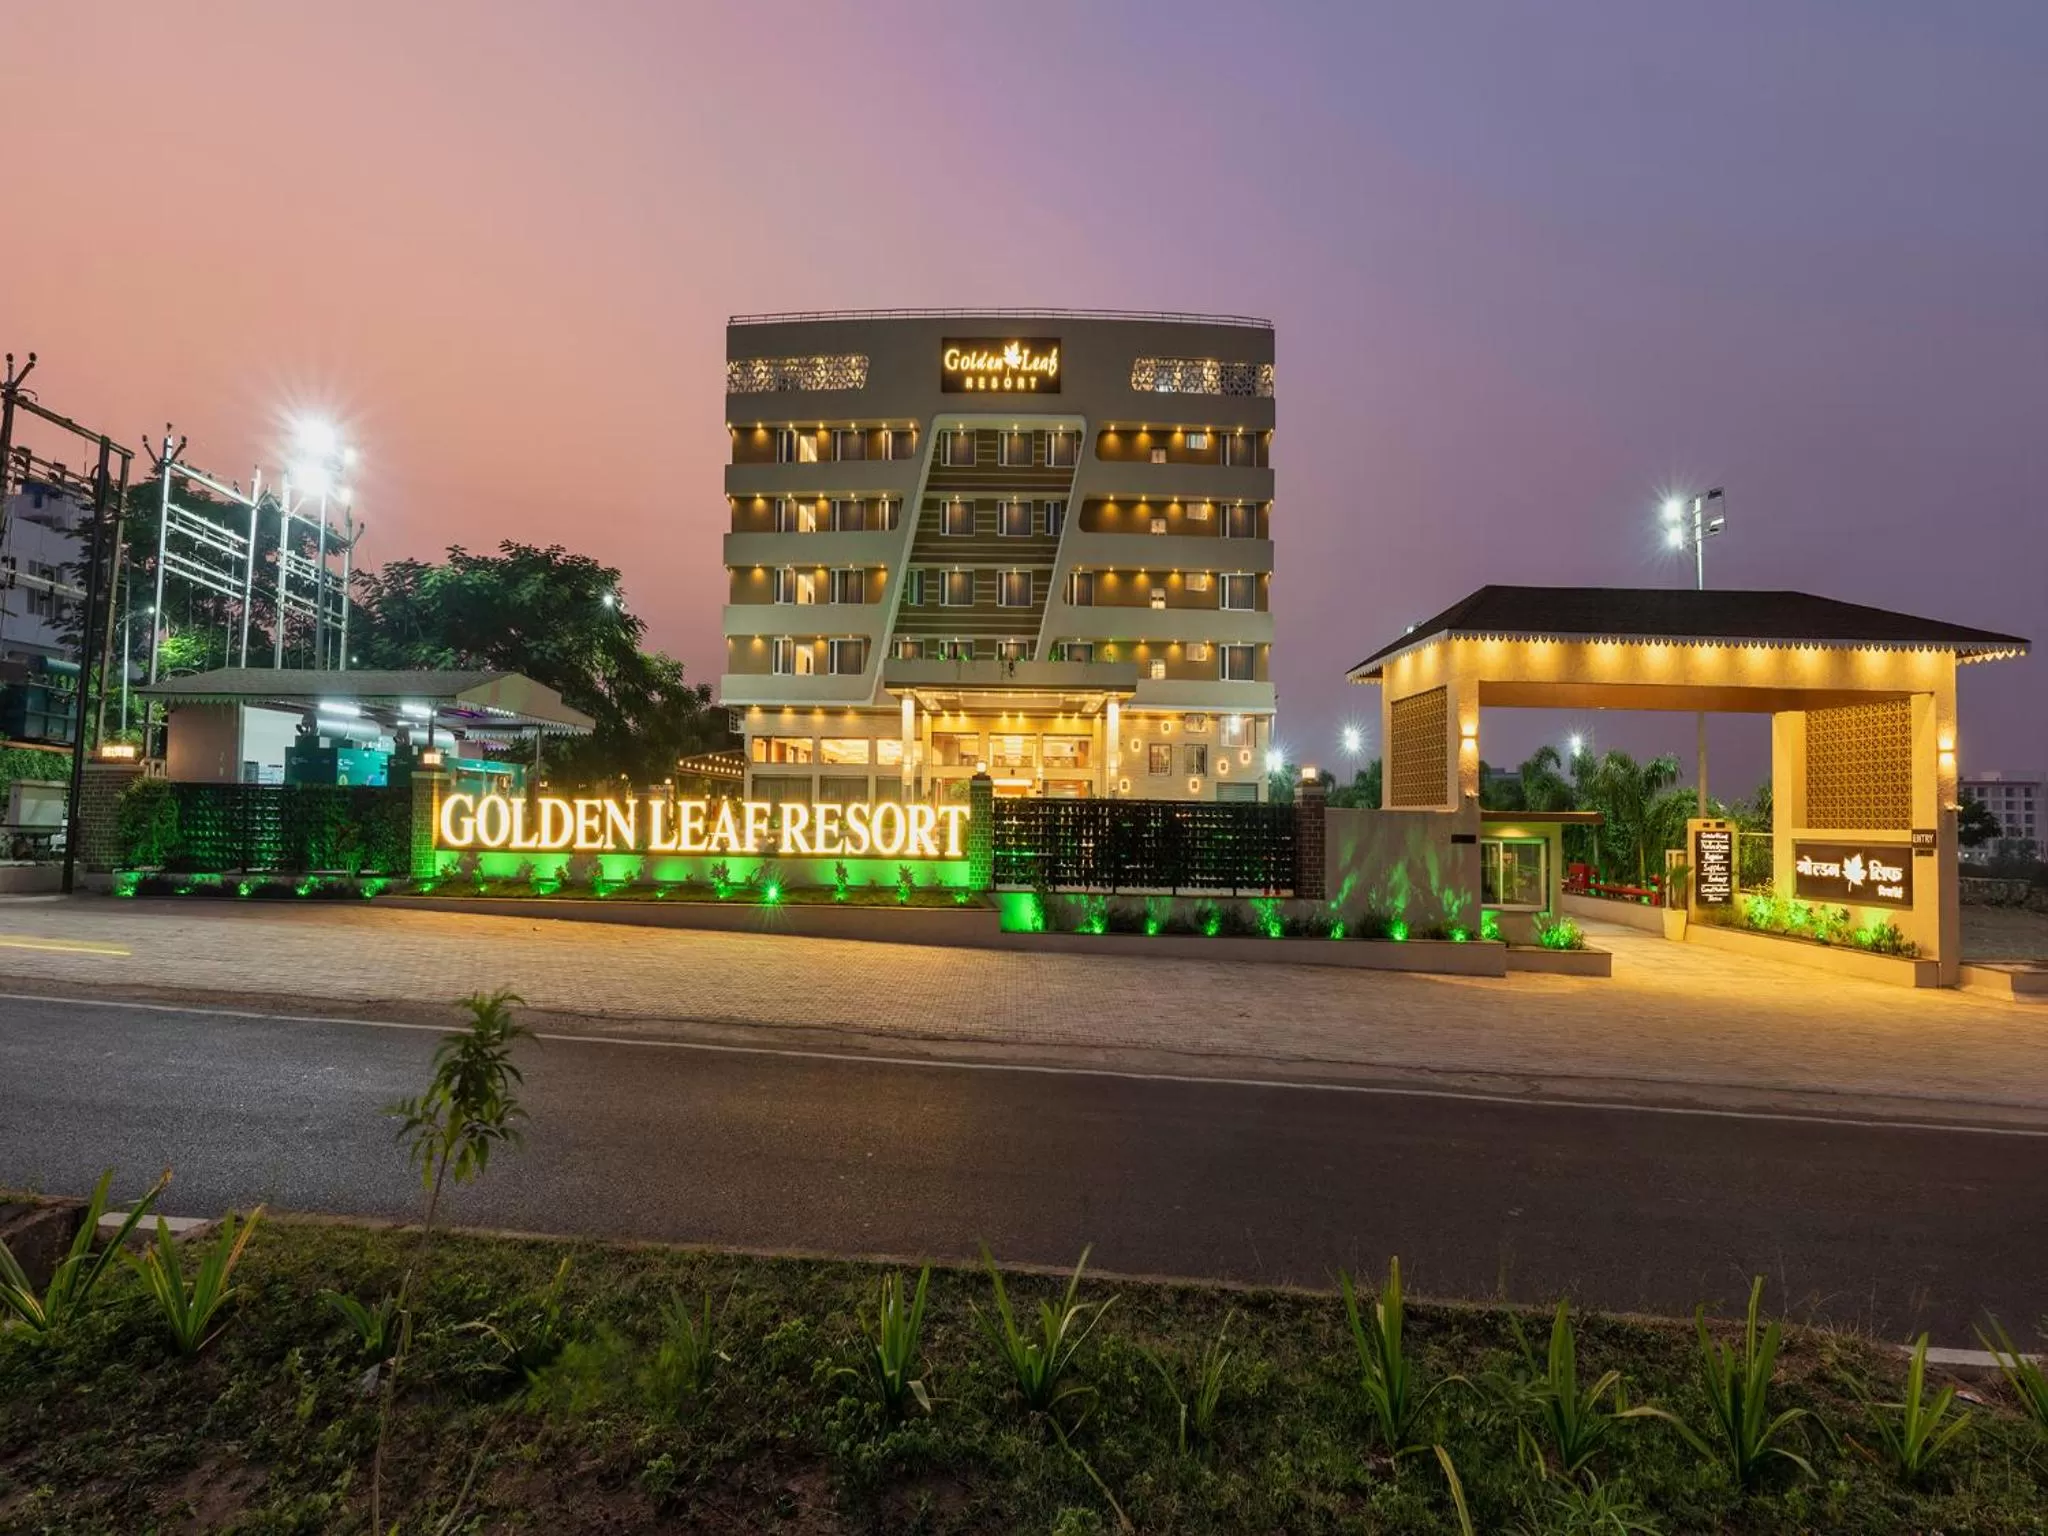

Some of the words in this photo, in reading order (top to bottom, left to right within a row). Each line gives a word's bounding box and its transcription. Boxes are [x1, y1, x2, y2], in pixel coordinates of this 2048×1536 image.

[944, 348, 1003, 371] Golden
[1021, 347, 1058, 377] Leaf
[965, 377, 1037, 389] RESORT
[440, 794, 638, 850] GOLDEN
[648, 798, 772, 853] LEAF
[779, 801, 971, 857] RESORT
[1912, 833, 1934, 844] ENTRY
